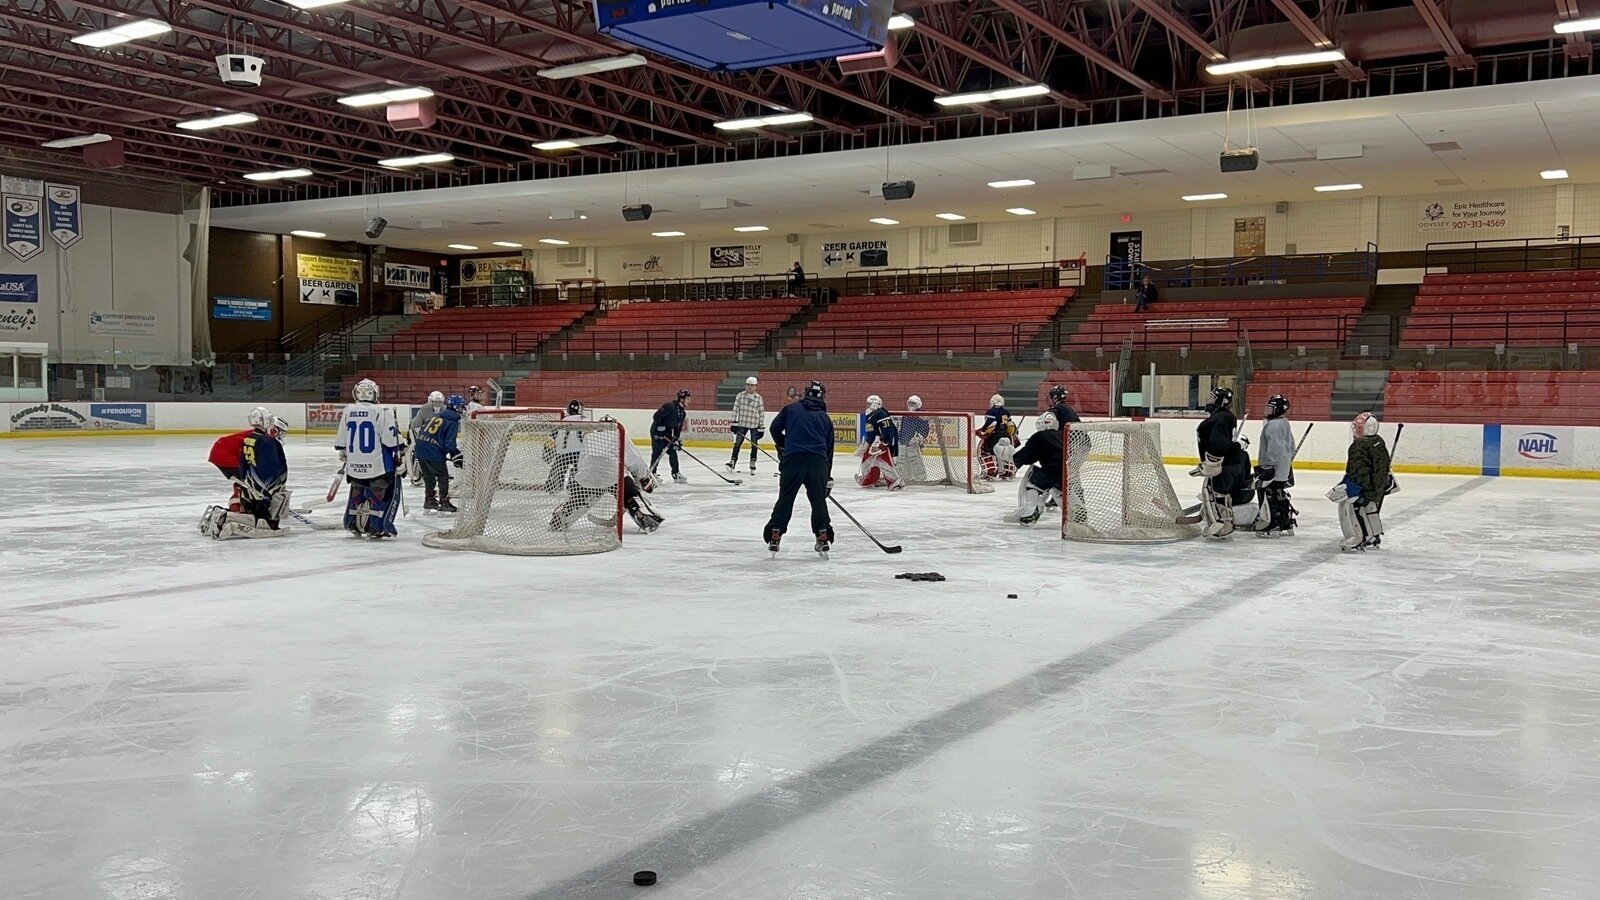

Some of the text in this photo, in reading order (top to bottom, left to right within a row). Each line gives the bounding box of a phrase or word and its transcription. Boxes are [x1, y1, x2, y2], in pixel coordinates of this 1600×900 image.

[832, 2, 852, 20] period
[1469, 201, 1504, 209] Healthcare
[1480, 209, 1506, 217] Journey!
[1452, 220, 1505, 229] 907-313-4569
[824, 241, 887, 251] BEER GARDEN
[325, 281, 356, 290] GARDEN
[882, 420, 889, 428] 31
[346, 421, 375, 453] 70
[835, 431, 855, 441] EPAIR
